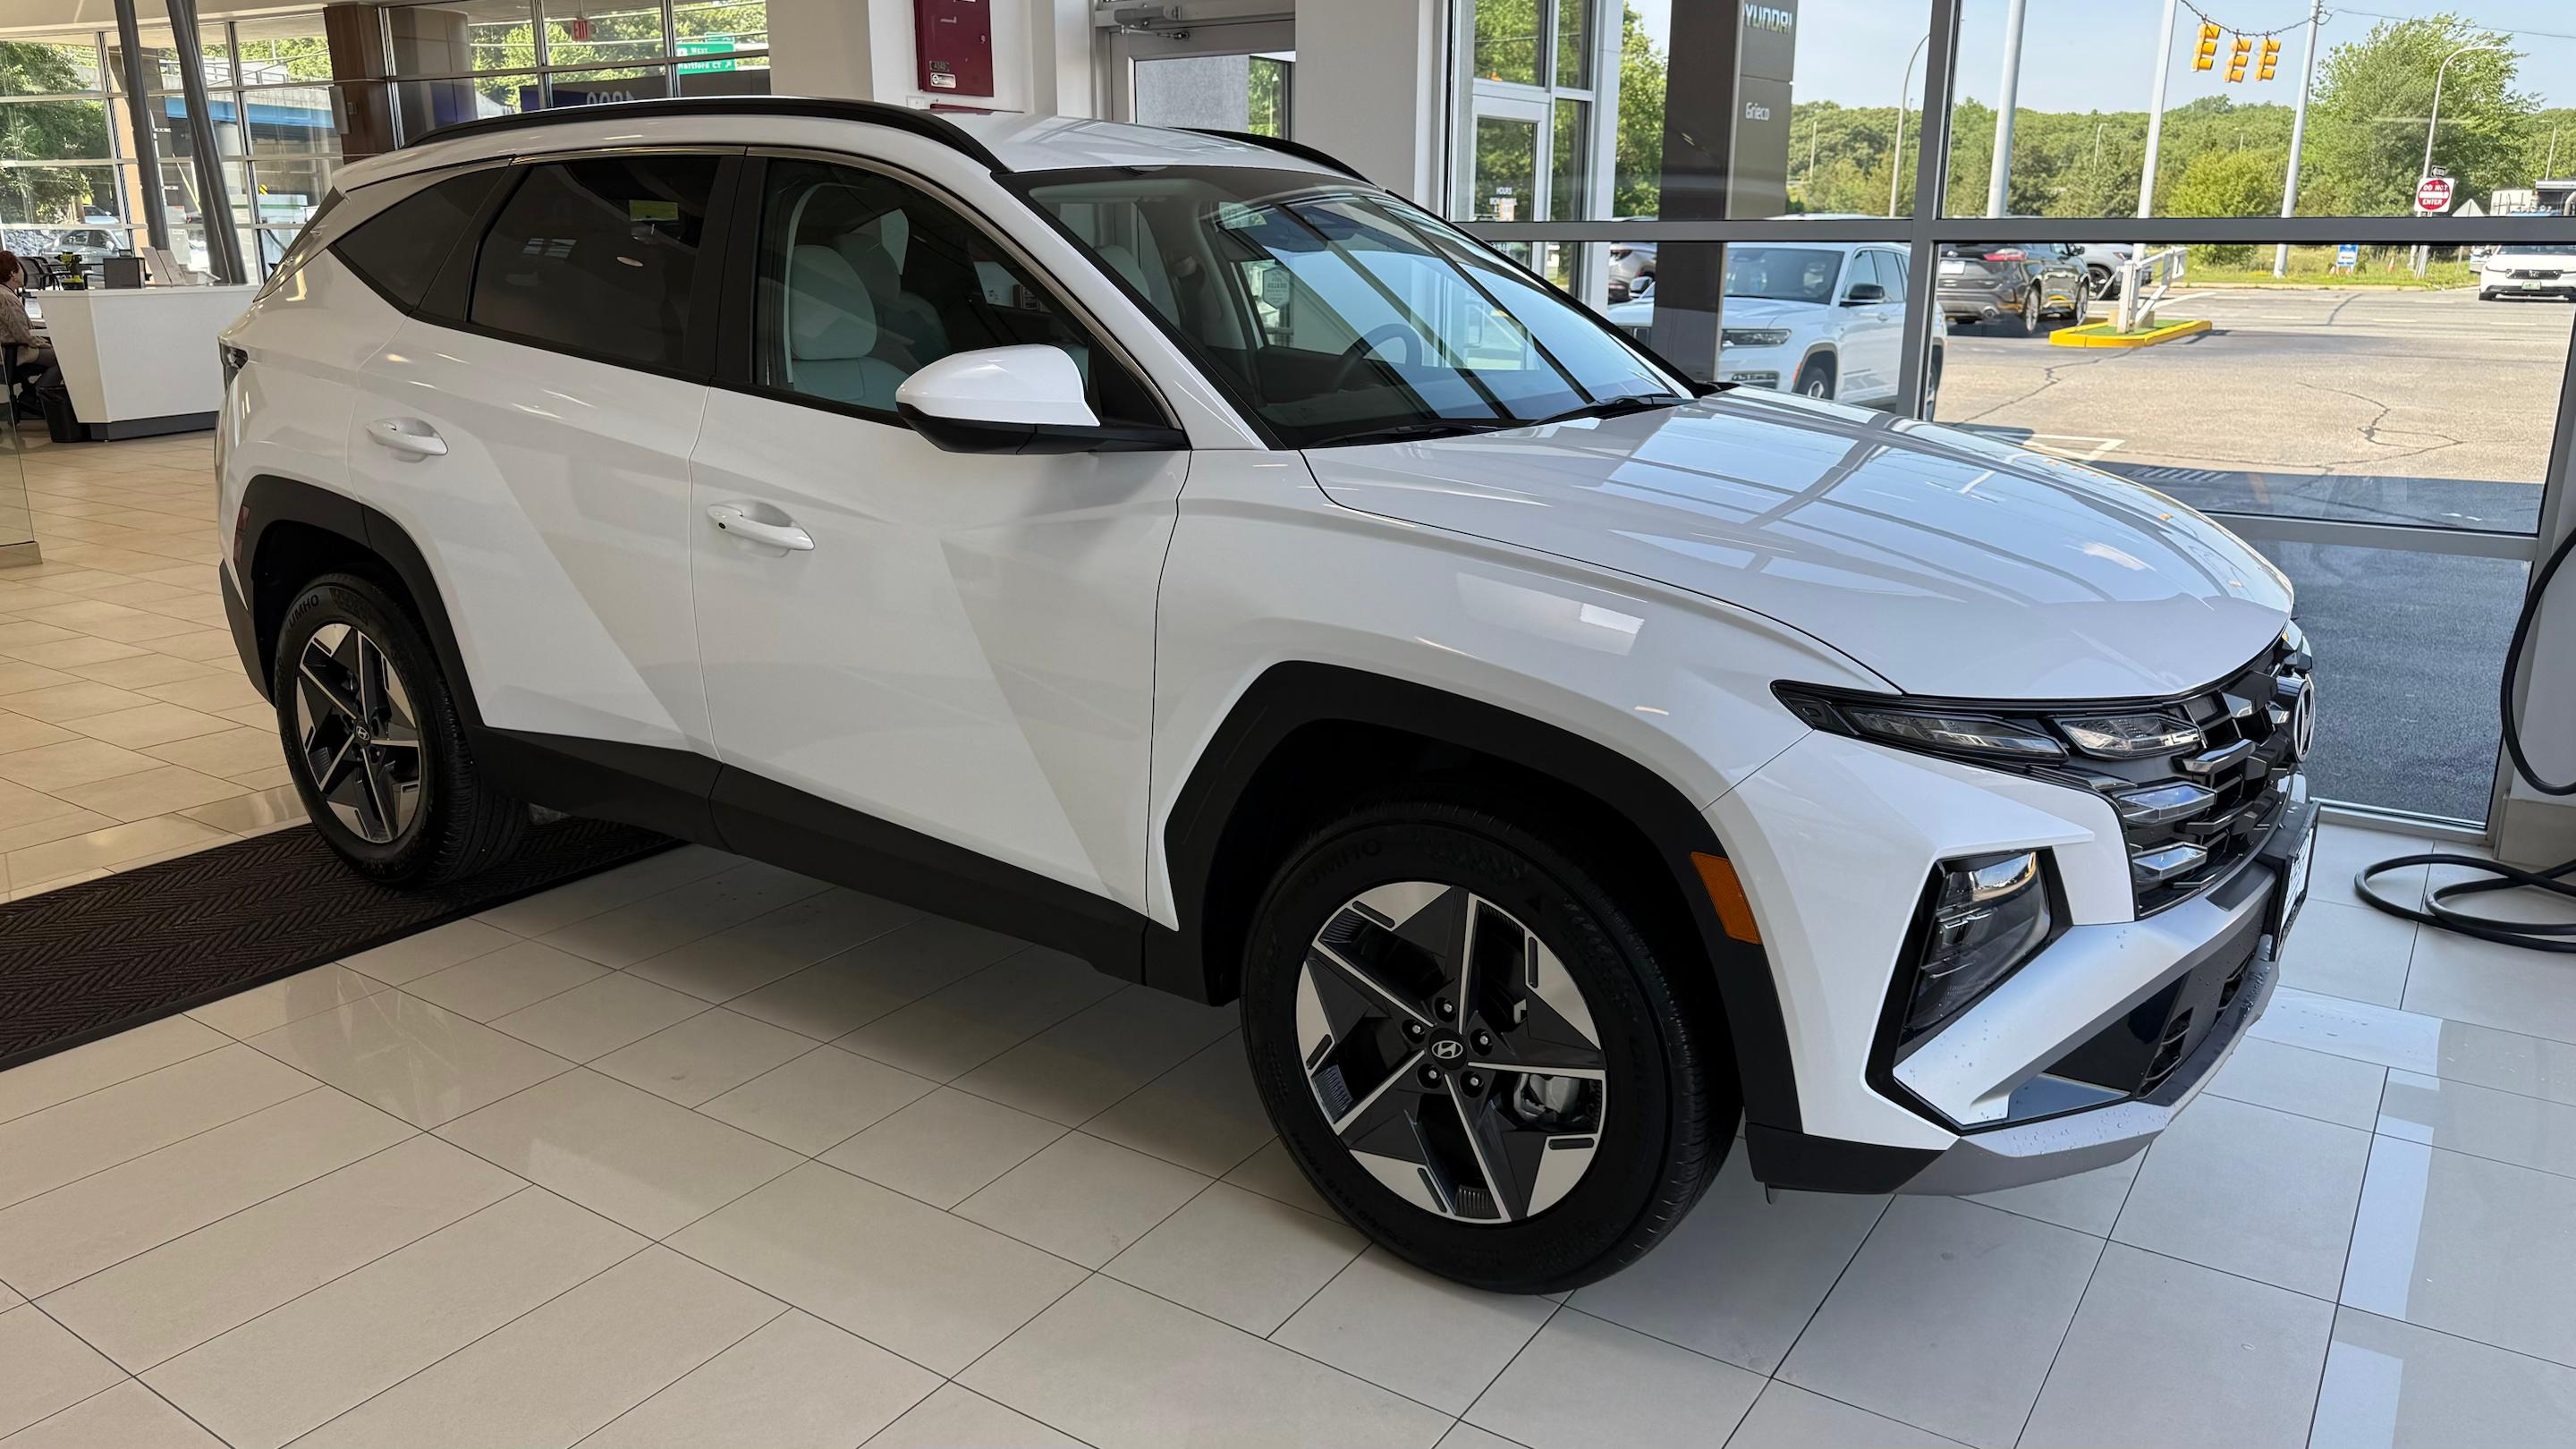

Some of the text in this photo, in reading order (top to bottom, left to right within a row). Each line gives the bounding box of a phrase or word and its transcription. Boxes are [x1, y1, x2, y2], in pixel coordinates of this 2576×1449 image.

[1745, 3, 1792, 34] YUNDAI
[1746, 101, 1770, 121] Grieco
[2422, 183, 2448, 191] DO NOT
[2422, 198, 2443, 206] ENTER
[288, 594, 319, 628] UMHO
